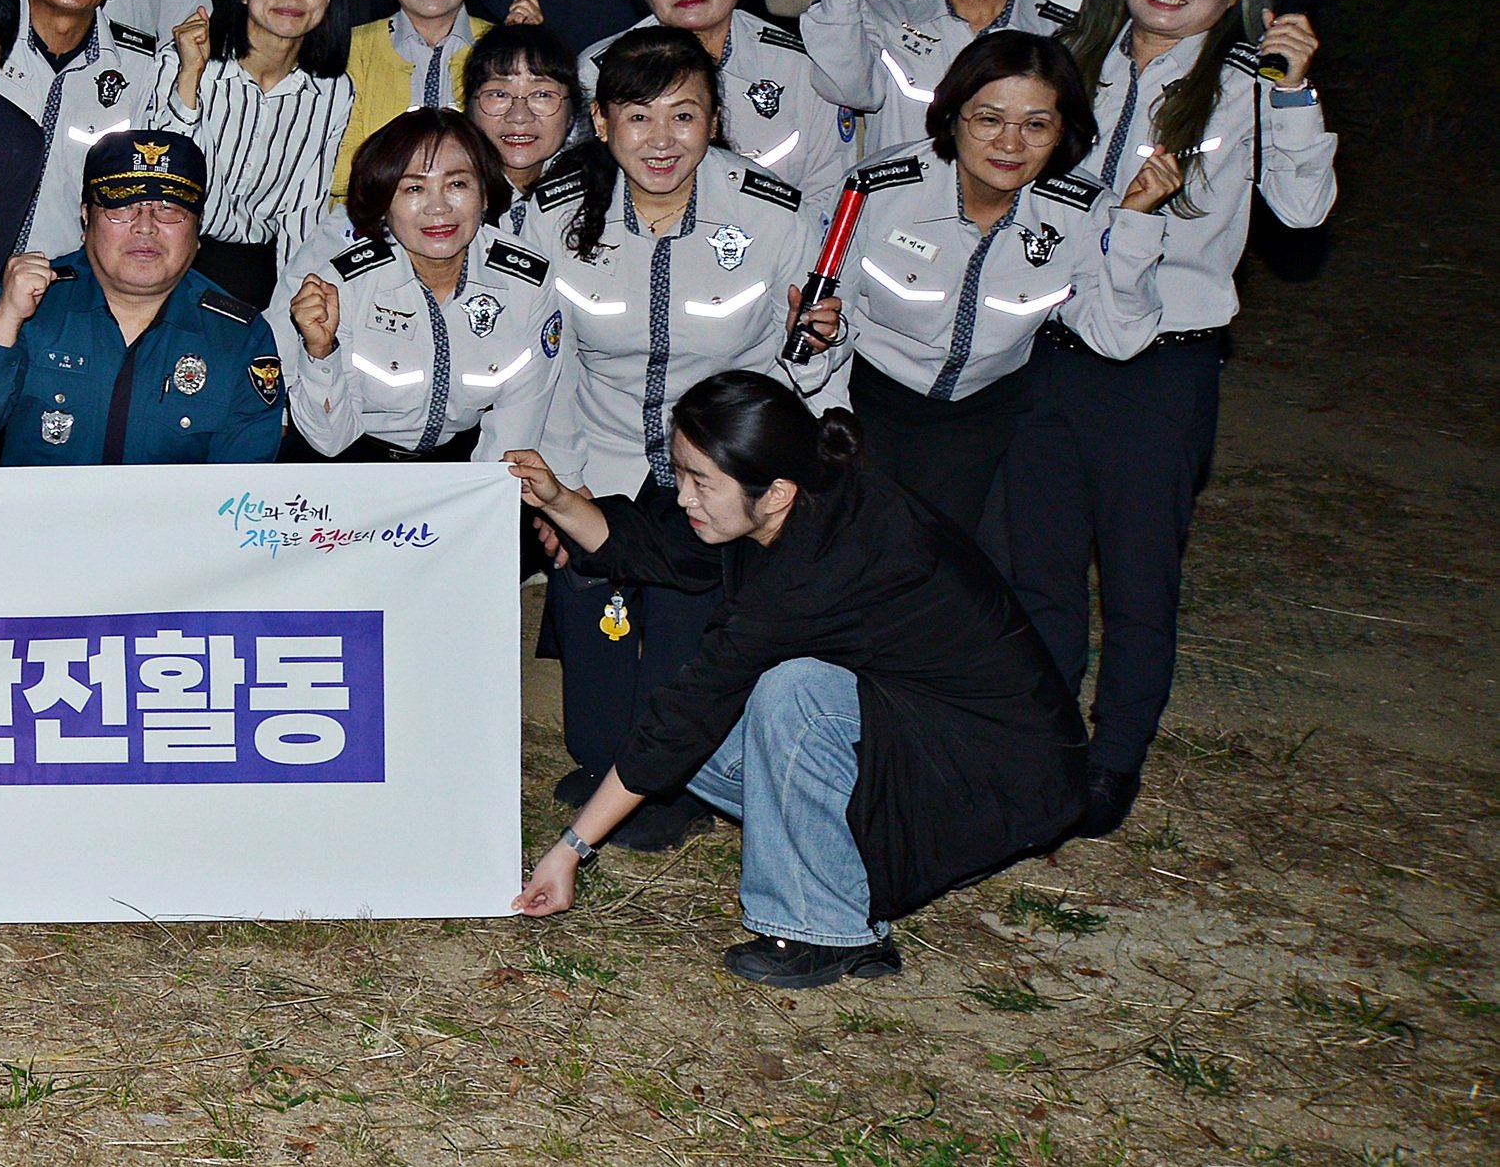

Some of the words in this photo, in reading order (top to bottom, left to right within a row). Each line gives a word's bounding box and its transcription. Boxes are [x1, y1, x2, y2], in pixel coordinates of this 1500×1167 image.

[217, 491, 284, 531] 시민과
[239, 528, 303, 560] 자유로운
[308, 527, 377, 554] 혁신도시
[380, 521, 441, 548] 안산
